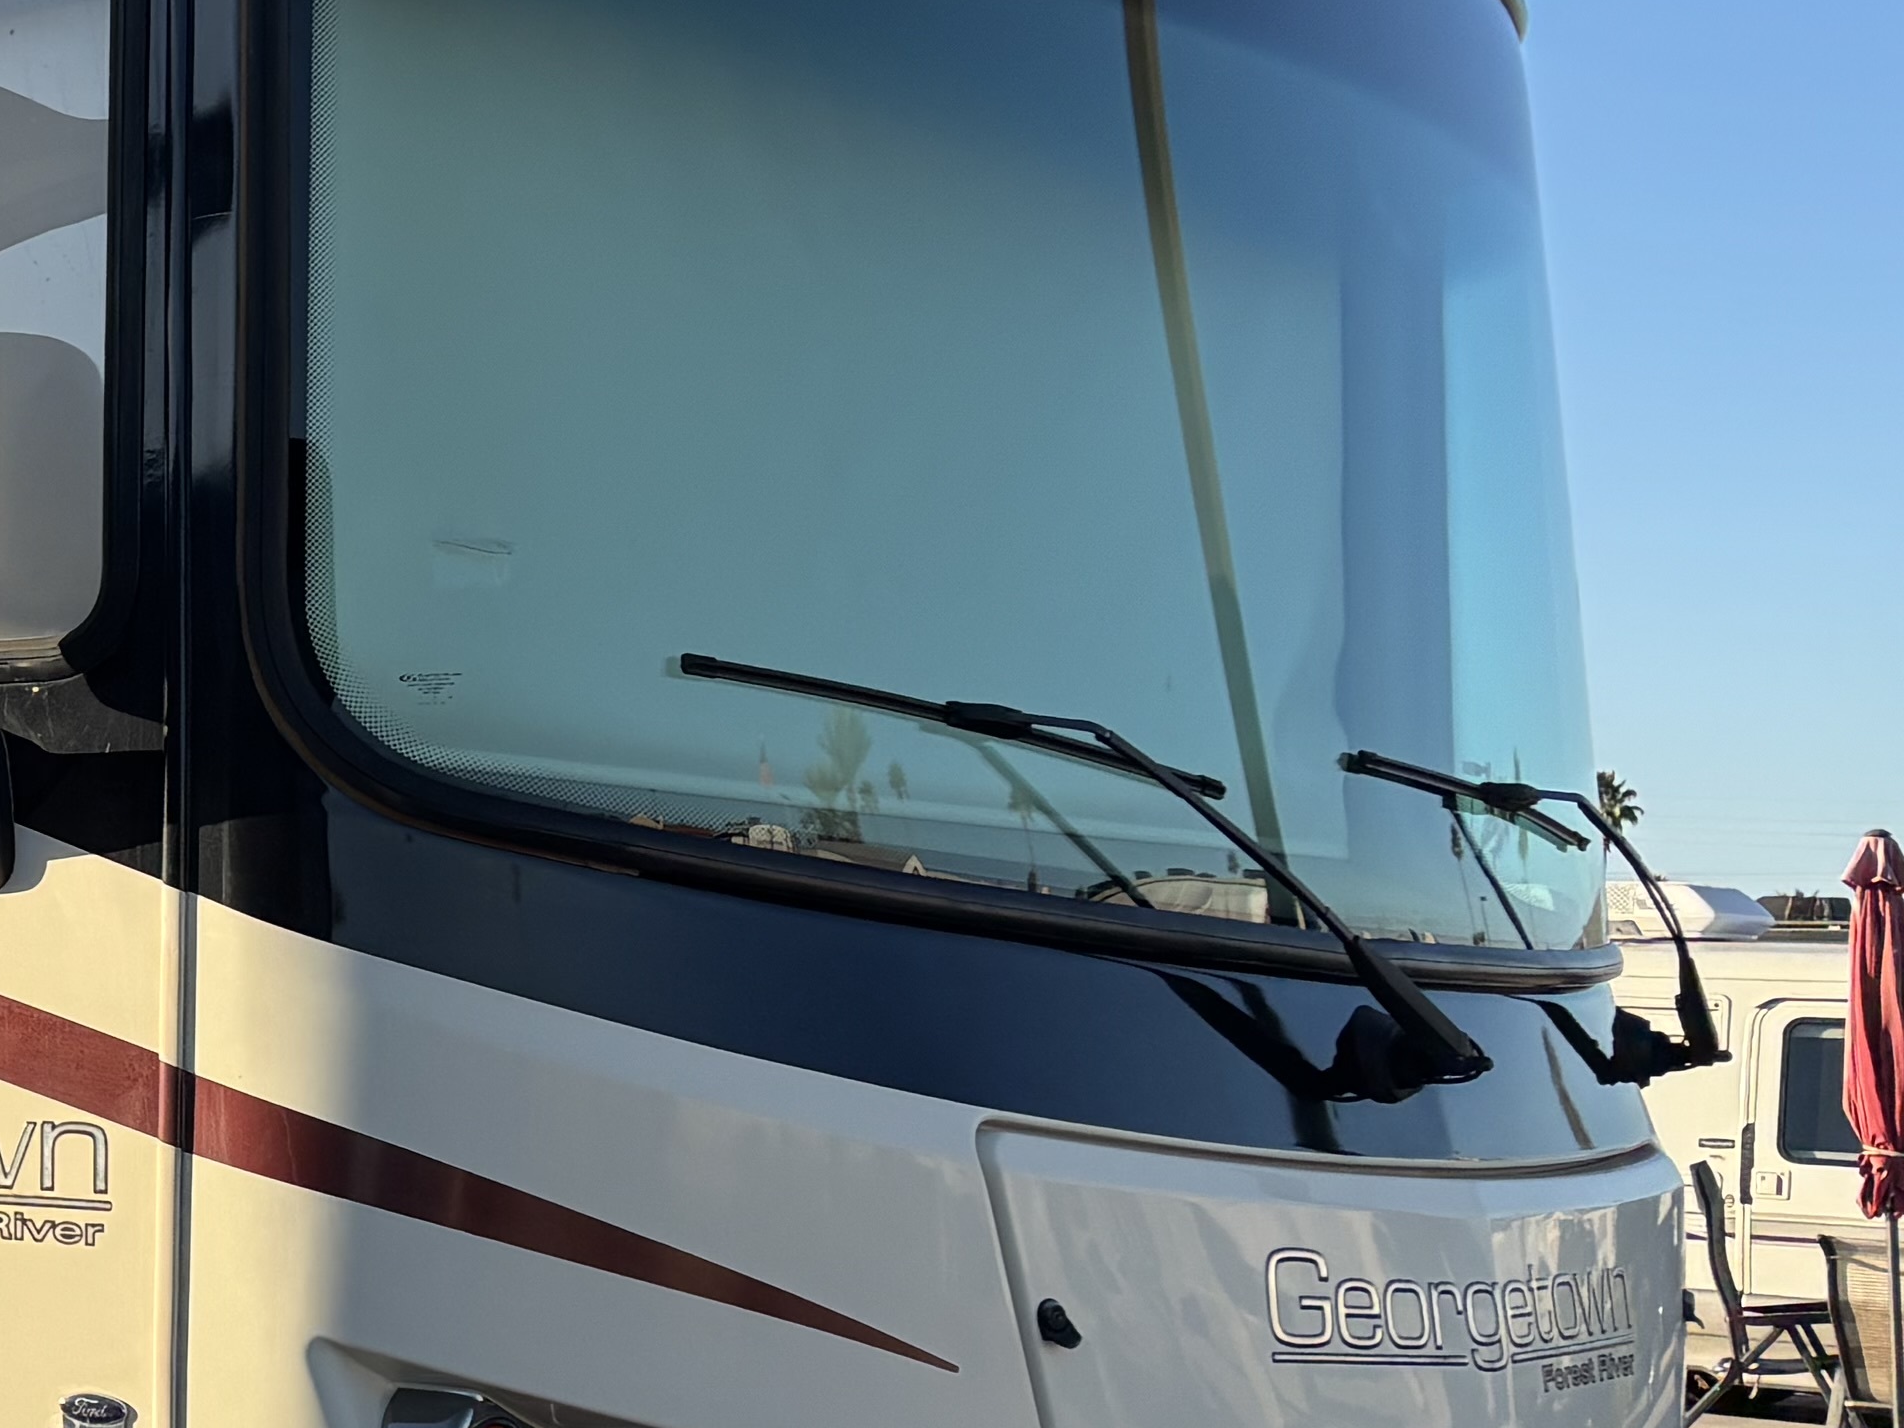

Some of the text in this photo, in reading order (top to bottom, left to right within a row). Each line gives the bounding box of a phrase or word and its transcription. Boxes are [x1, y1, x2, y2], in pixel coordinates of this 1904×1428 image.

[1266, 1247, 1632, 1372] Georgetown
[1542, 1353, 1634, 1393] Forest River
[72, 1397, 108, 1418] Ford
